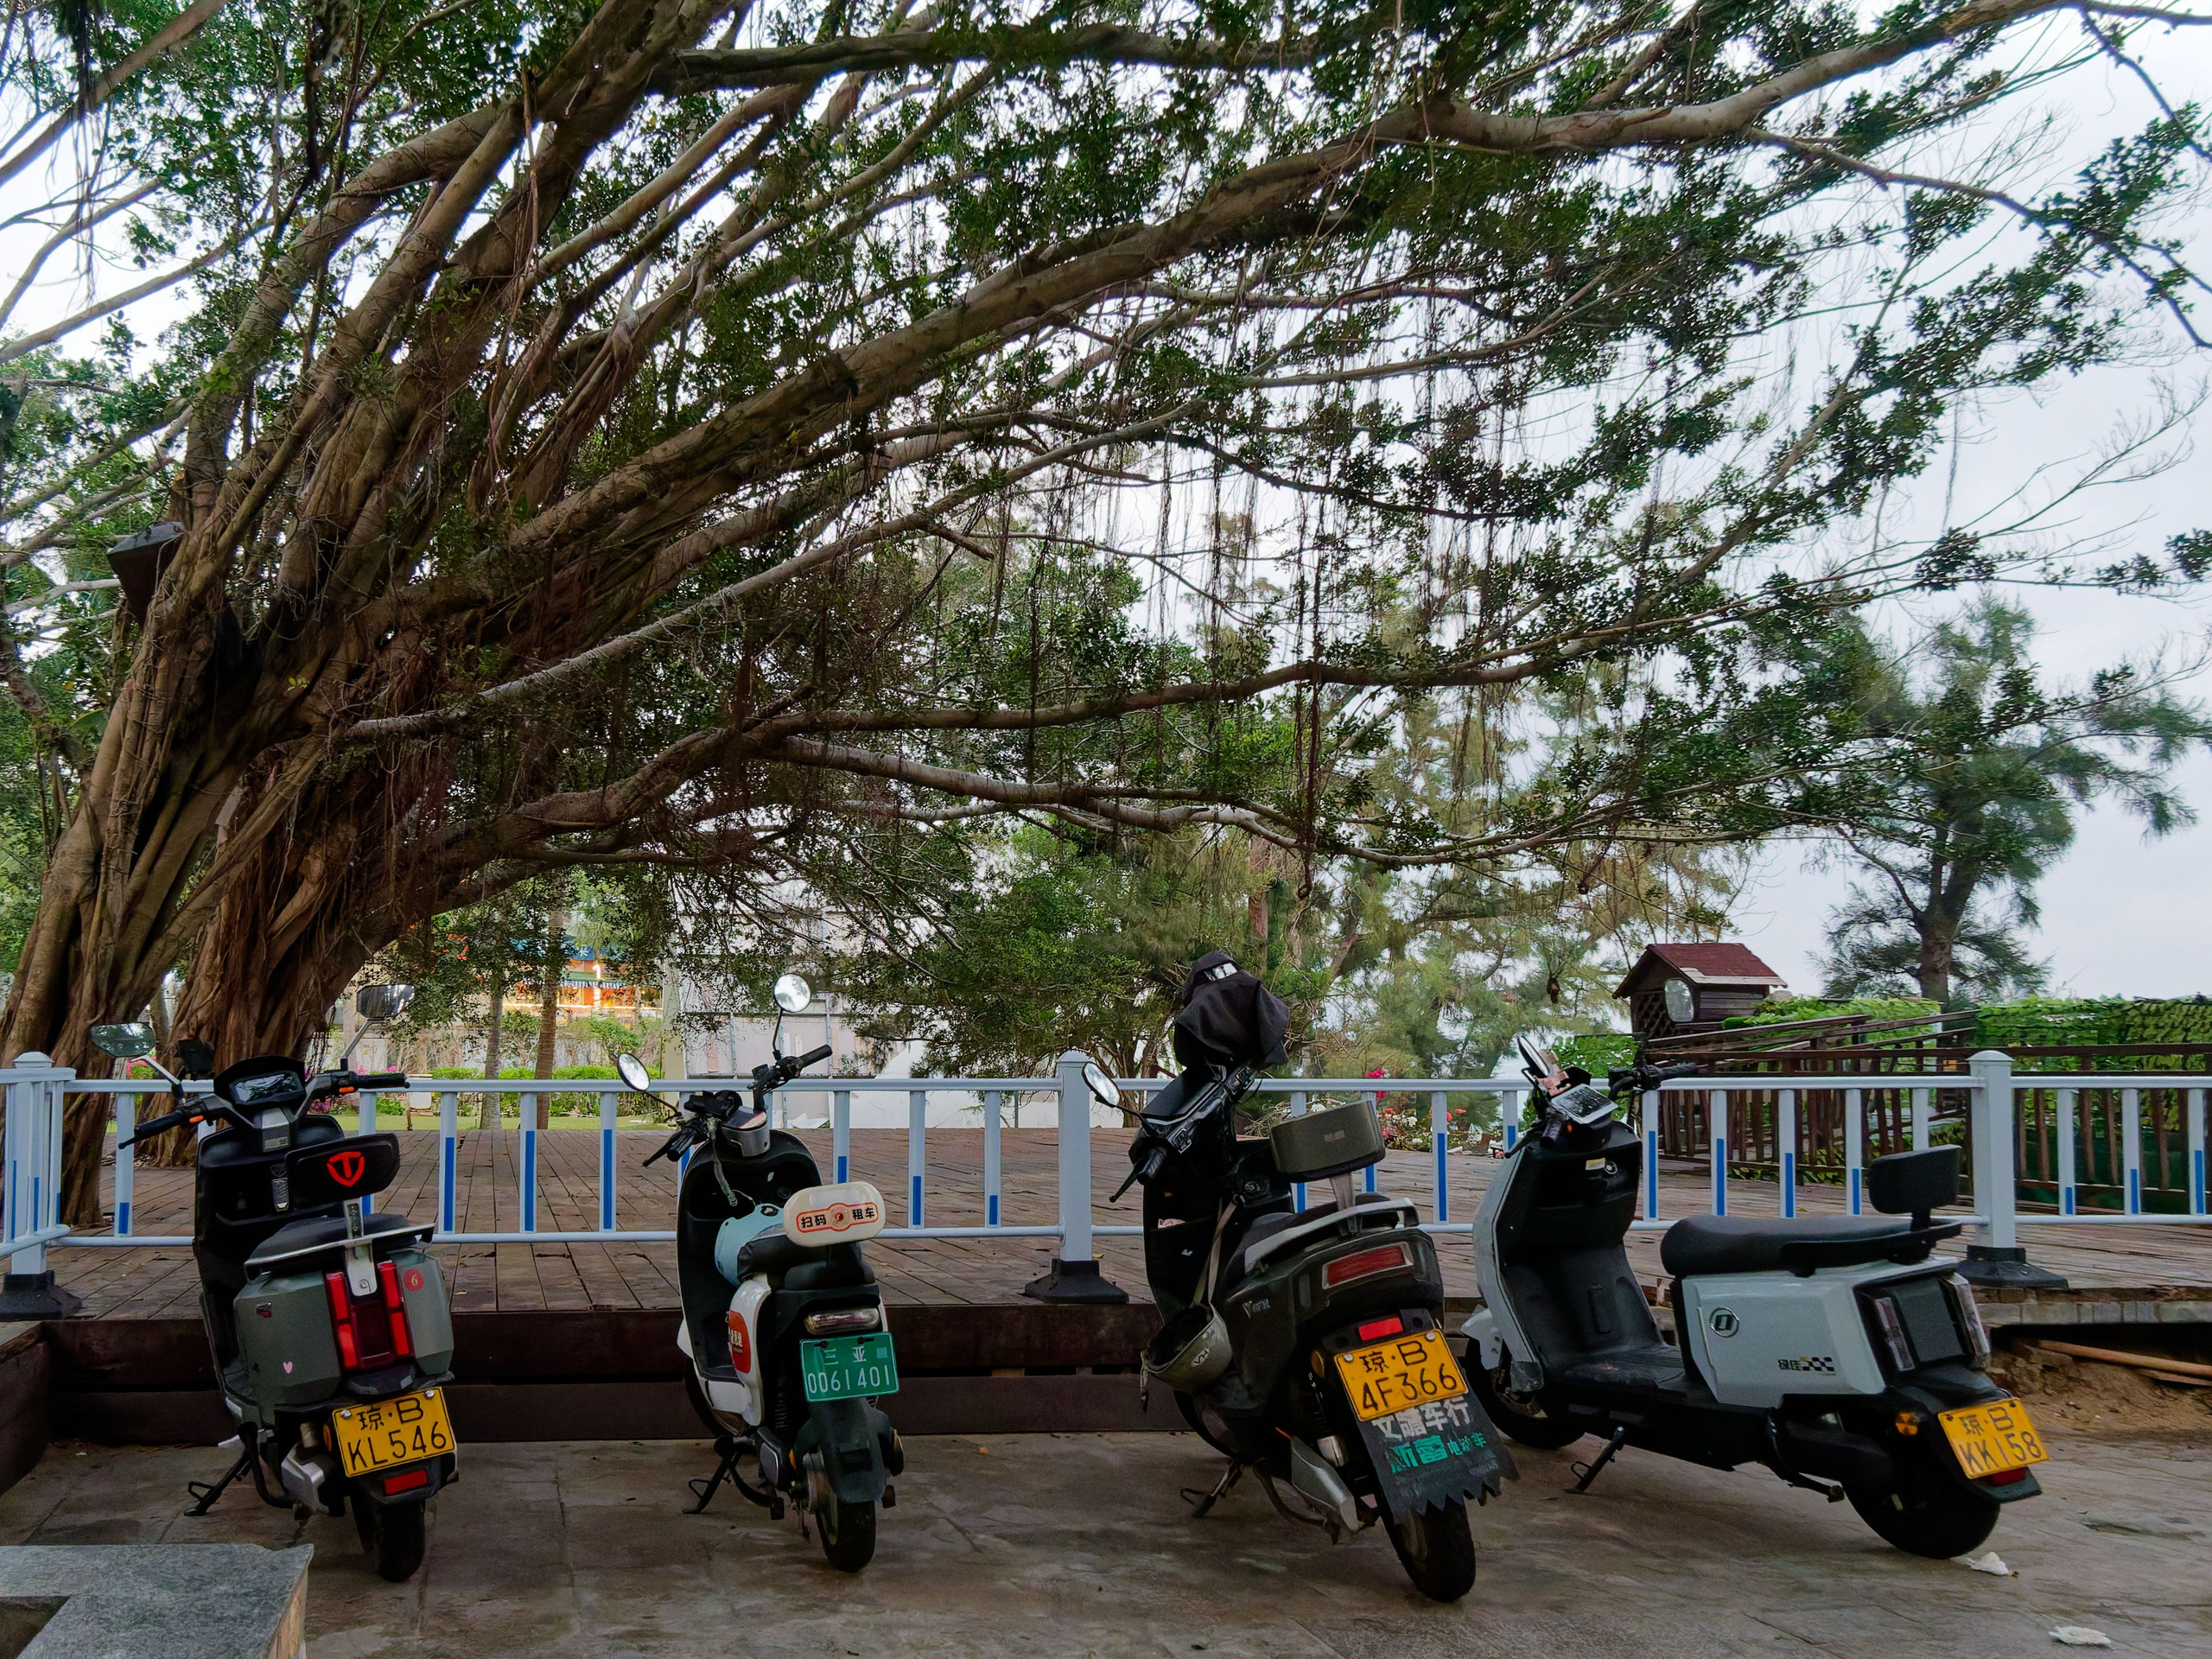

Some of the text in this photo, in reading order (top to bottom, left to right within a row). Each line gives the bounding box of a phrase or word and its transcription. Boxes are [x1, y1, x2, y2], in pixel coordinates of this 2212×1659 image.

[801, 1207, 875, 1228] 扫码 租车
[824, 1345, 867, 1365] 三亚
[1359, 1340, 1427, 1373] 琼·B
[807, 1365, 890, 1394] 0061401
[1363, 1363, 1458, 1411] 4F366
[357, 1397, 424, 1431] 琼·B
[347, 1421, 447, 1471] KL546
[1959, 1431, 2042, 1473] KK158
